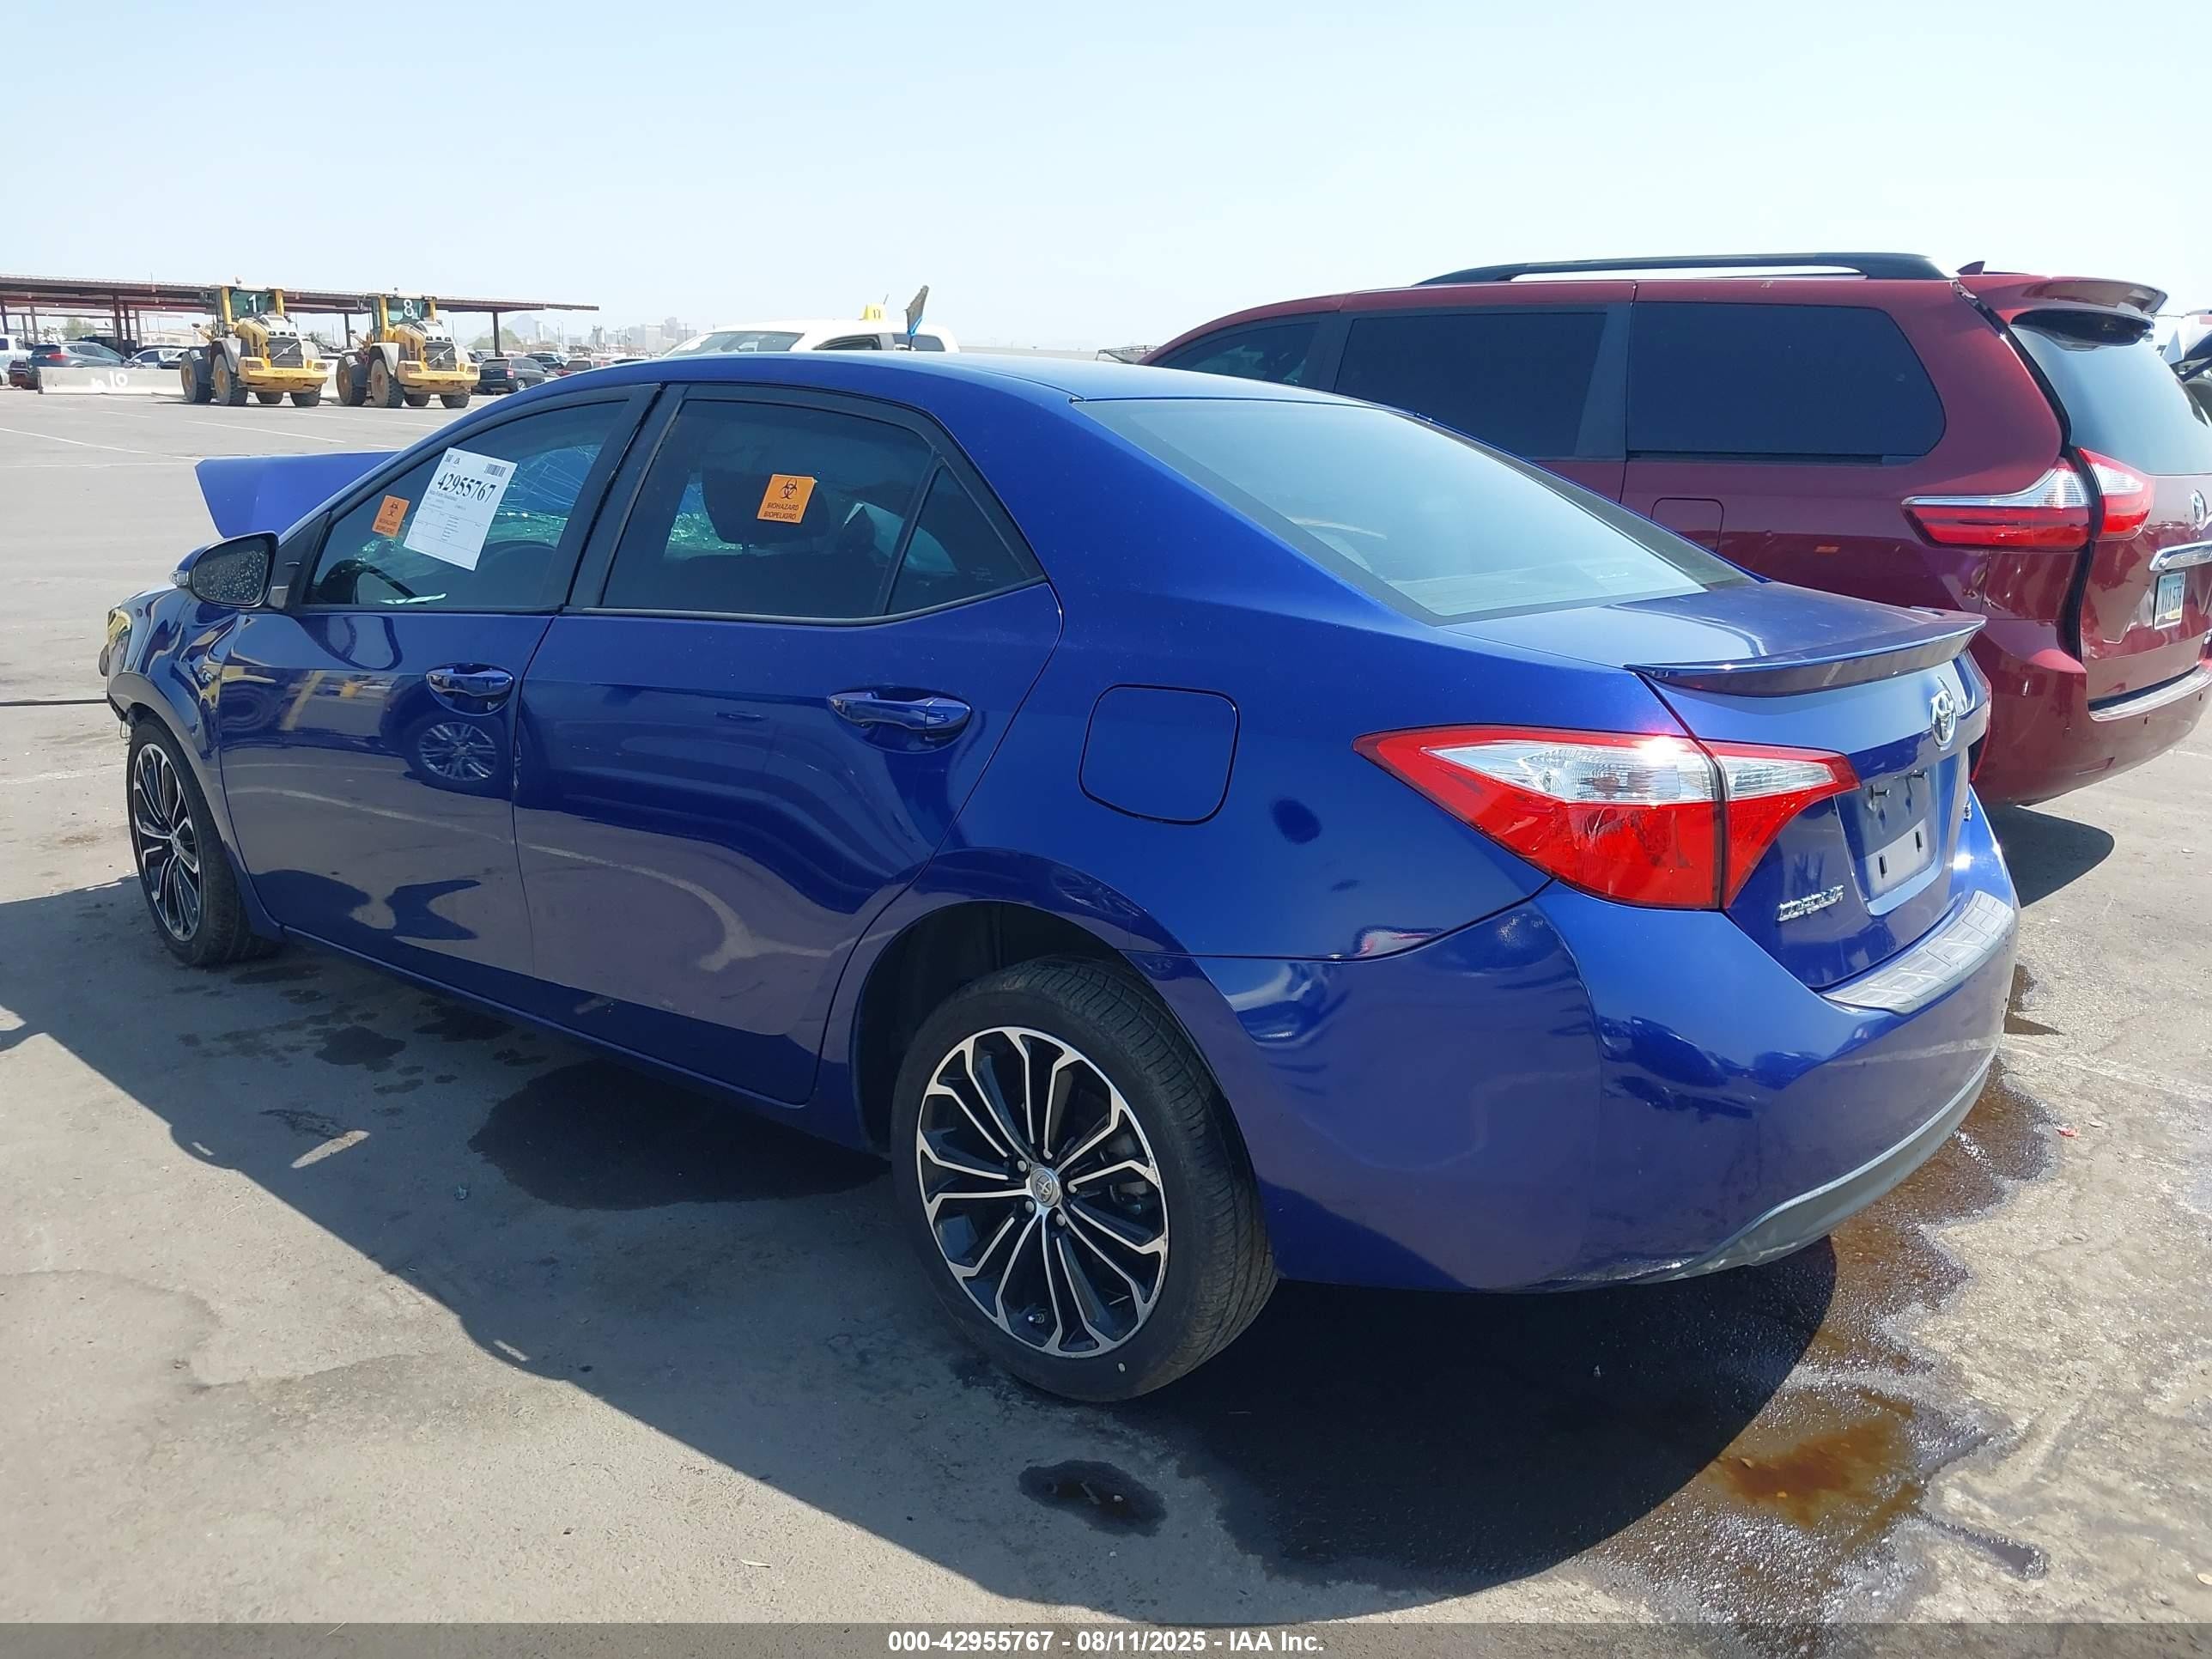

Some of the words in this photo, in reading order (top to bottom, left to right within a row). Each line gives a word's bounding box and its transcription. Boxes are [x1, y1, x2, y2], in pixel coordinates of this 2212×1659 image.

[248, 294, 258, 313] 1
[404, 299, 415, 318] 8
[437, 471, 497, 503] 42955767
[763, 511, 797, 520] BIOPELIGRO
[767, 502, 799, 511] BIOHAZARD
